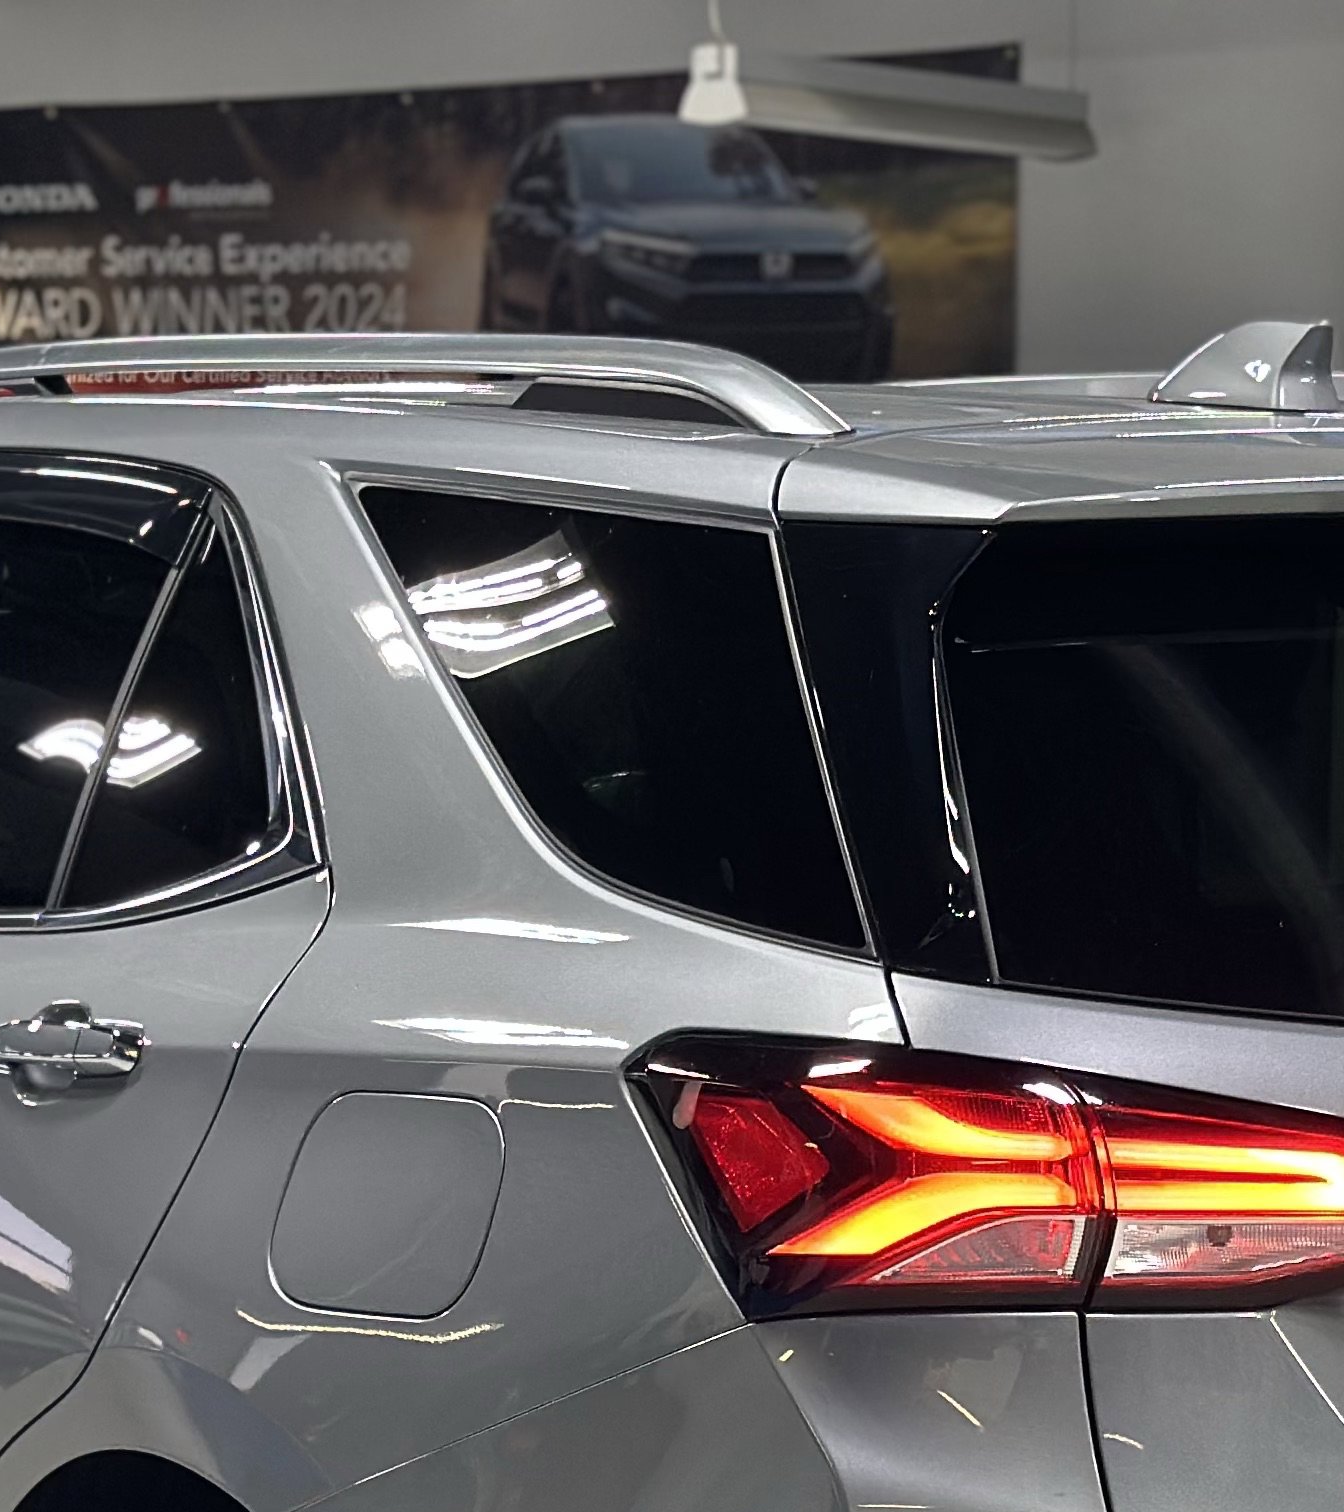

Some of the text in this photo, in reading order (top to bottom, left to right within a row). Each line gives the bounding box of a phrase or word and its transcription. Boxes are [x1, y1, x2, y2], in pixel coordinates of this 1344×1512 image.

[101, 234, 213, 278] Service
[219, 232, 411, 283] Experience
[112, 283, 291, 336] WINNER
[302, 282, 407, 335] 2024
